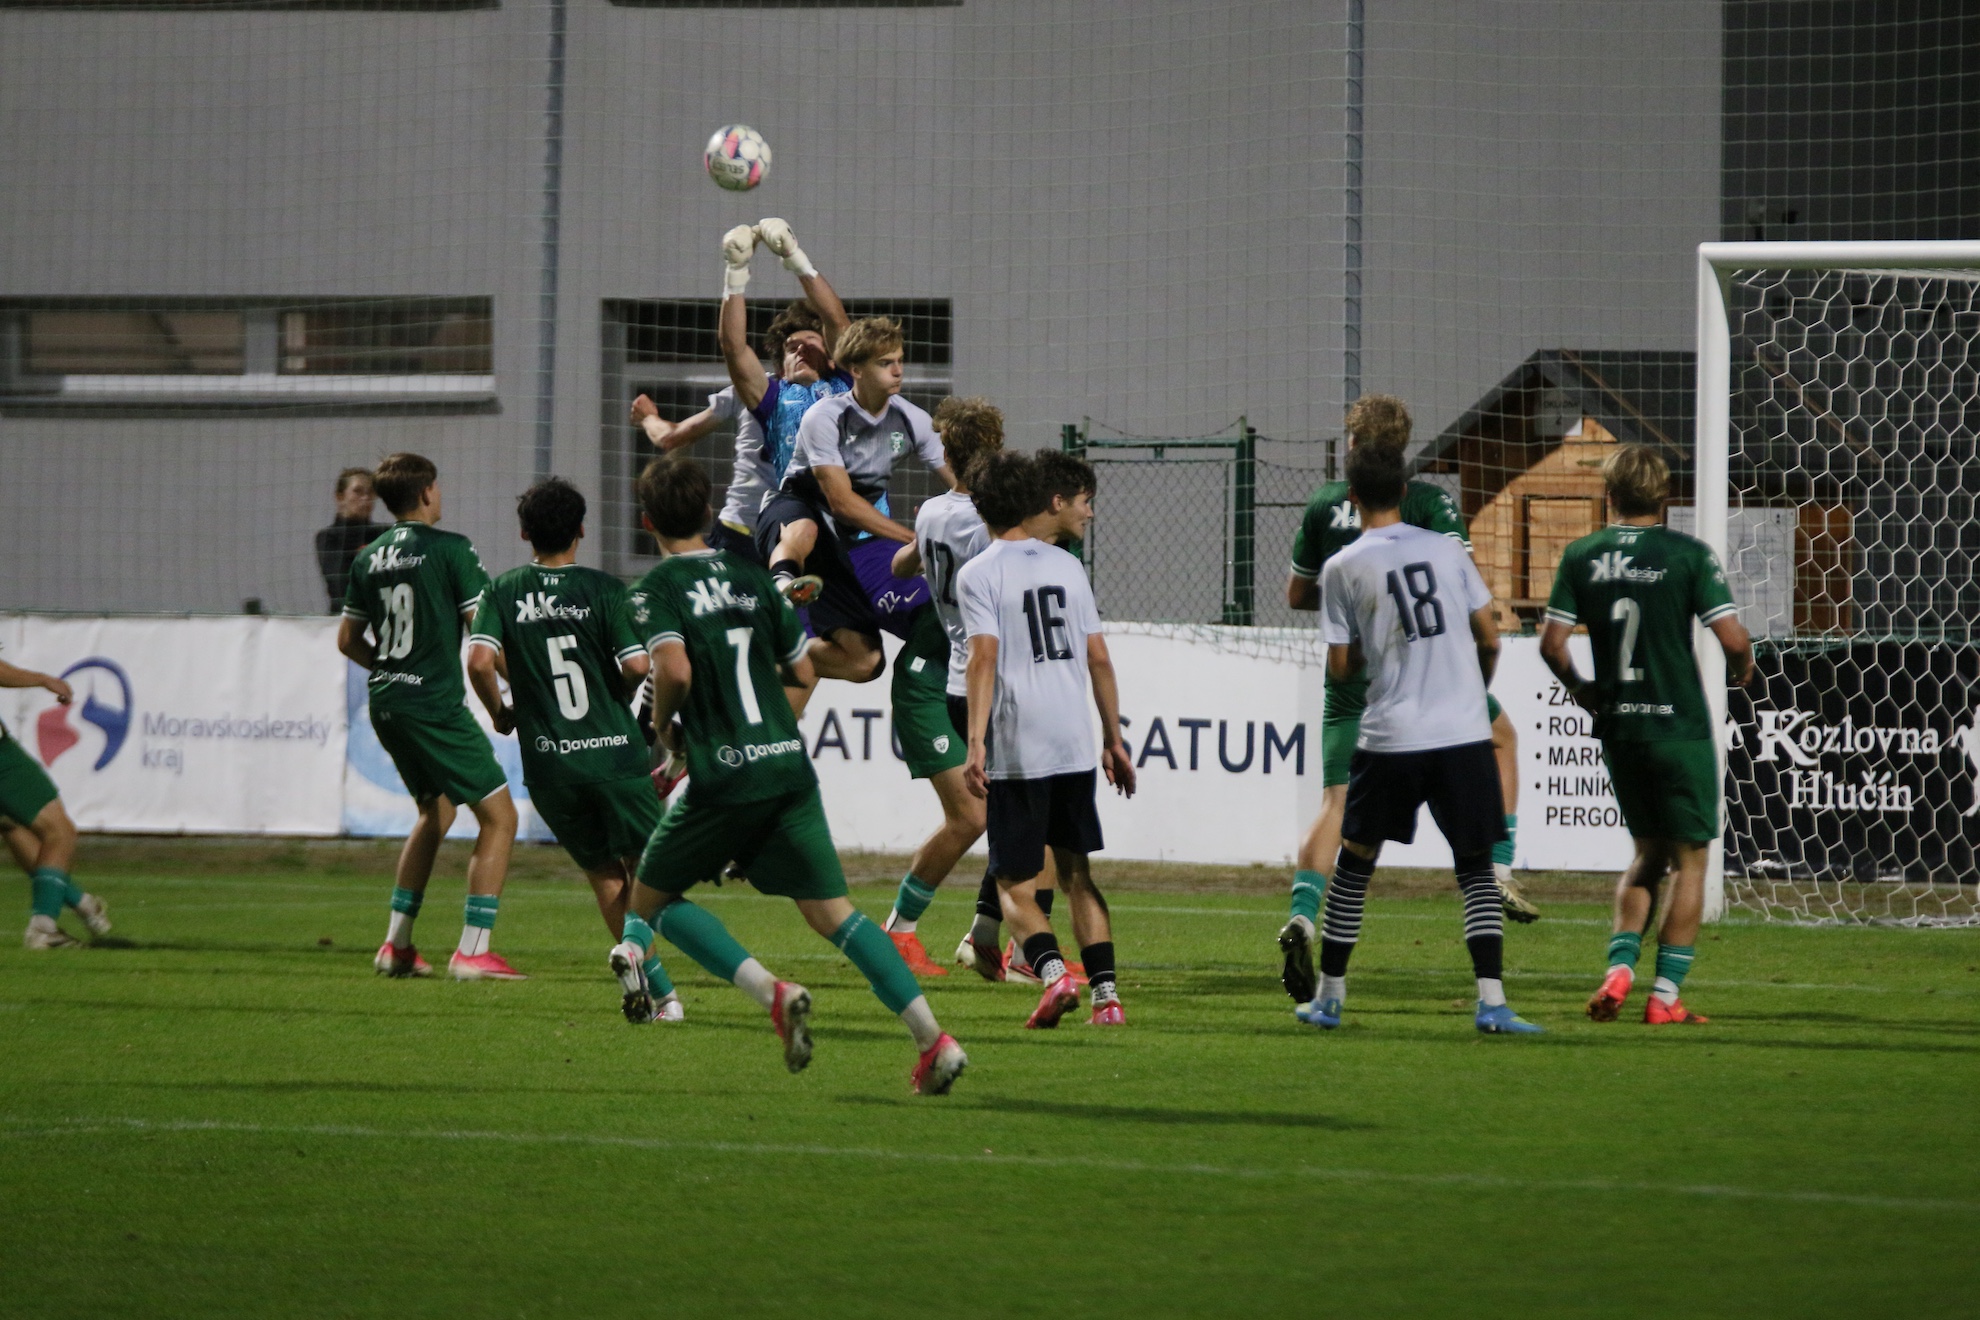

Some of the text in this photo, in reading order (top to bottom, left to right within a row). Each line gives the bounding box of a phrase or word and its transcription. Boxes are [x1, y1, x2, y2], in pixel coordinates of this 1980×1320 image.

[877, 590, 902, 614] 22
[1023, 584, 1074, 664] 16
[1386, 560, 1447, 643] 18
[1610, 596, 1645, 682] 2
[545, 634, 590, 721] 5
[142, 740, 184, 777] kraj
[800, 707, 905, 762] AT
[1756, 709, 1942, 767] Kozlovna
[1548, 771, 1615, 797] HLINÍK
[1789, 769, 1914, 812] Hlučín
